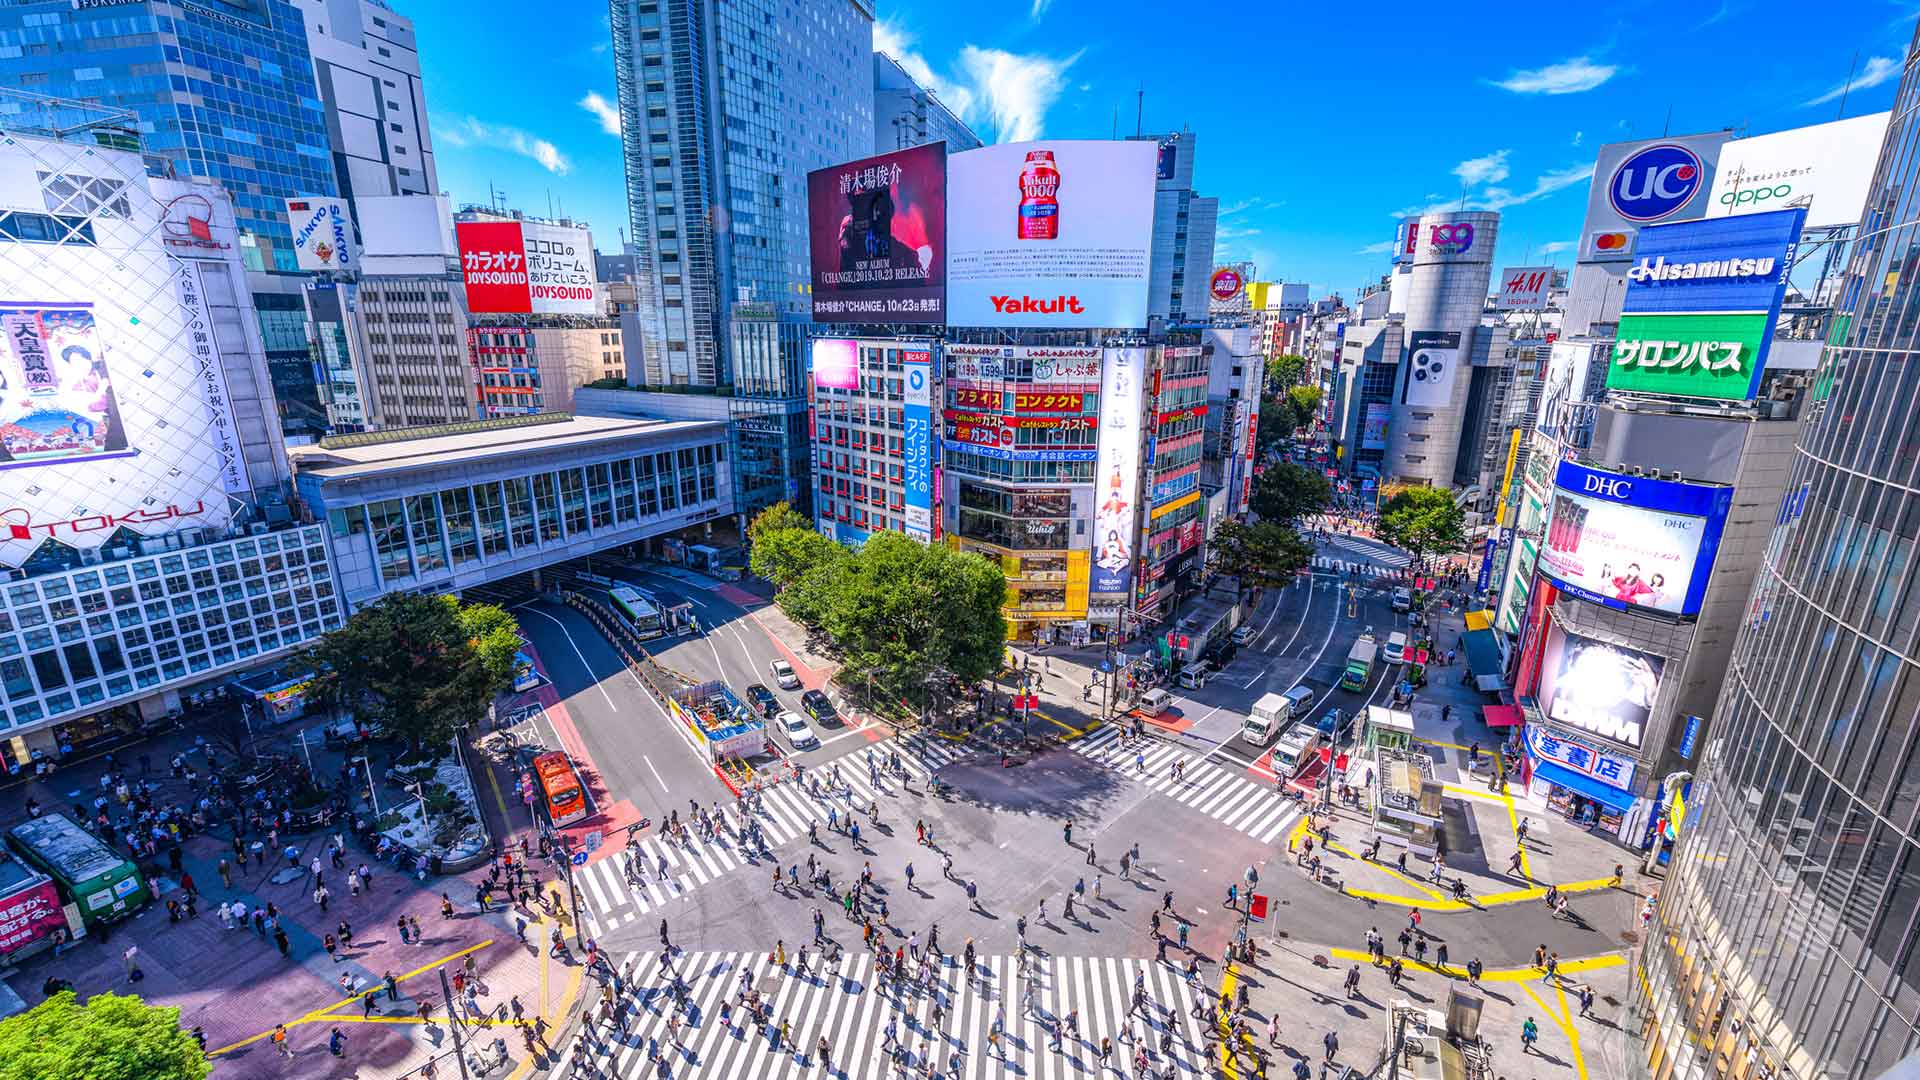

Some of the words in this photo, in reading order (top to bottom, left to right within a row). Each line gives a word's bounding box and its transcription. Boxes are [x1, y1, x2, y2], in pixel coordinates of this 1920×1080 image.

[839, 163, 902, 194] 清木場俊介
[1023, 175, 1057, 185] Yakult
[1619, 163, 1690, 202] UC
[1024, 185, 1056, 197] 1000
[1720, 185, 1792, 207] oppo
[296, 207, 327, 249] SANKYO
[330, 204, 349, 263] SANKYO
[163, 238, 232, 250] TOKYU
[525, 238, 576, 257] ココロの
[1430, 223, 1473, 254] 109
[464, 250, 523, 271] カラオケ
[528, 256, 590, 275] ボリューム、
[855, 260, 867, 269] NEW
[869, 258, 890, 269] ALBUM
[1627, 256, 1775, 283] Hisamitsu
[1778, 243, 1797, 286] サロンパス
[467, 272, 526, 285] JOYSOUND
[530, 272, 592, 286] あげていこう。
[895, 268, 930, 280] RELEASE
[1505, 271, 1546, 294] H&M
[530, 286, 593, 300] JOYSOUND
[991, 296, 1085, 314] Yakult
[14, 322, 52, 384] 天皇賞(秋)
[1616, 339, 1743, 372] サロンパス
[1015, 394, 1081, 409] コンタクト
[946, 425, 957, 436] 7F
[982, 414, 1005, 428] ガスト
[1060, 418, 1091, 431] ガスト
[971, 427, 998, 444] ガスト
[906, 418, 919, 490] アイシティ
[919, 418, 928, 493] コンタクトの
[1584, 474, 1632, 499] DHC
[30, 501, 204, 537] TOKYU
[1663, 519, 1690, 530] DHC
[1564, 584, 1578, 595] DHC
[1578, 589, 1605, 604] Channel
